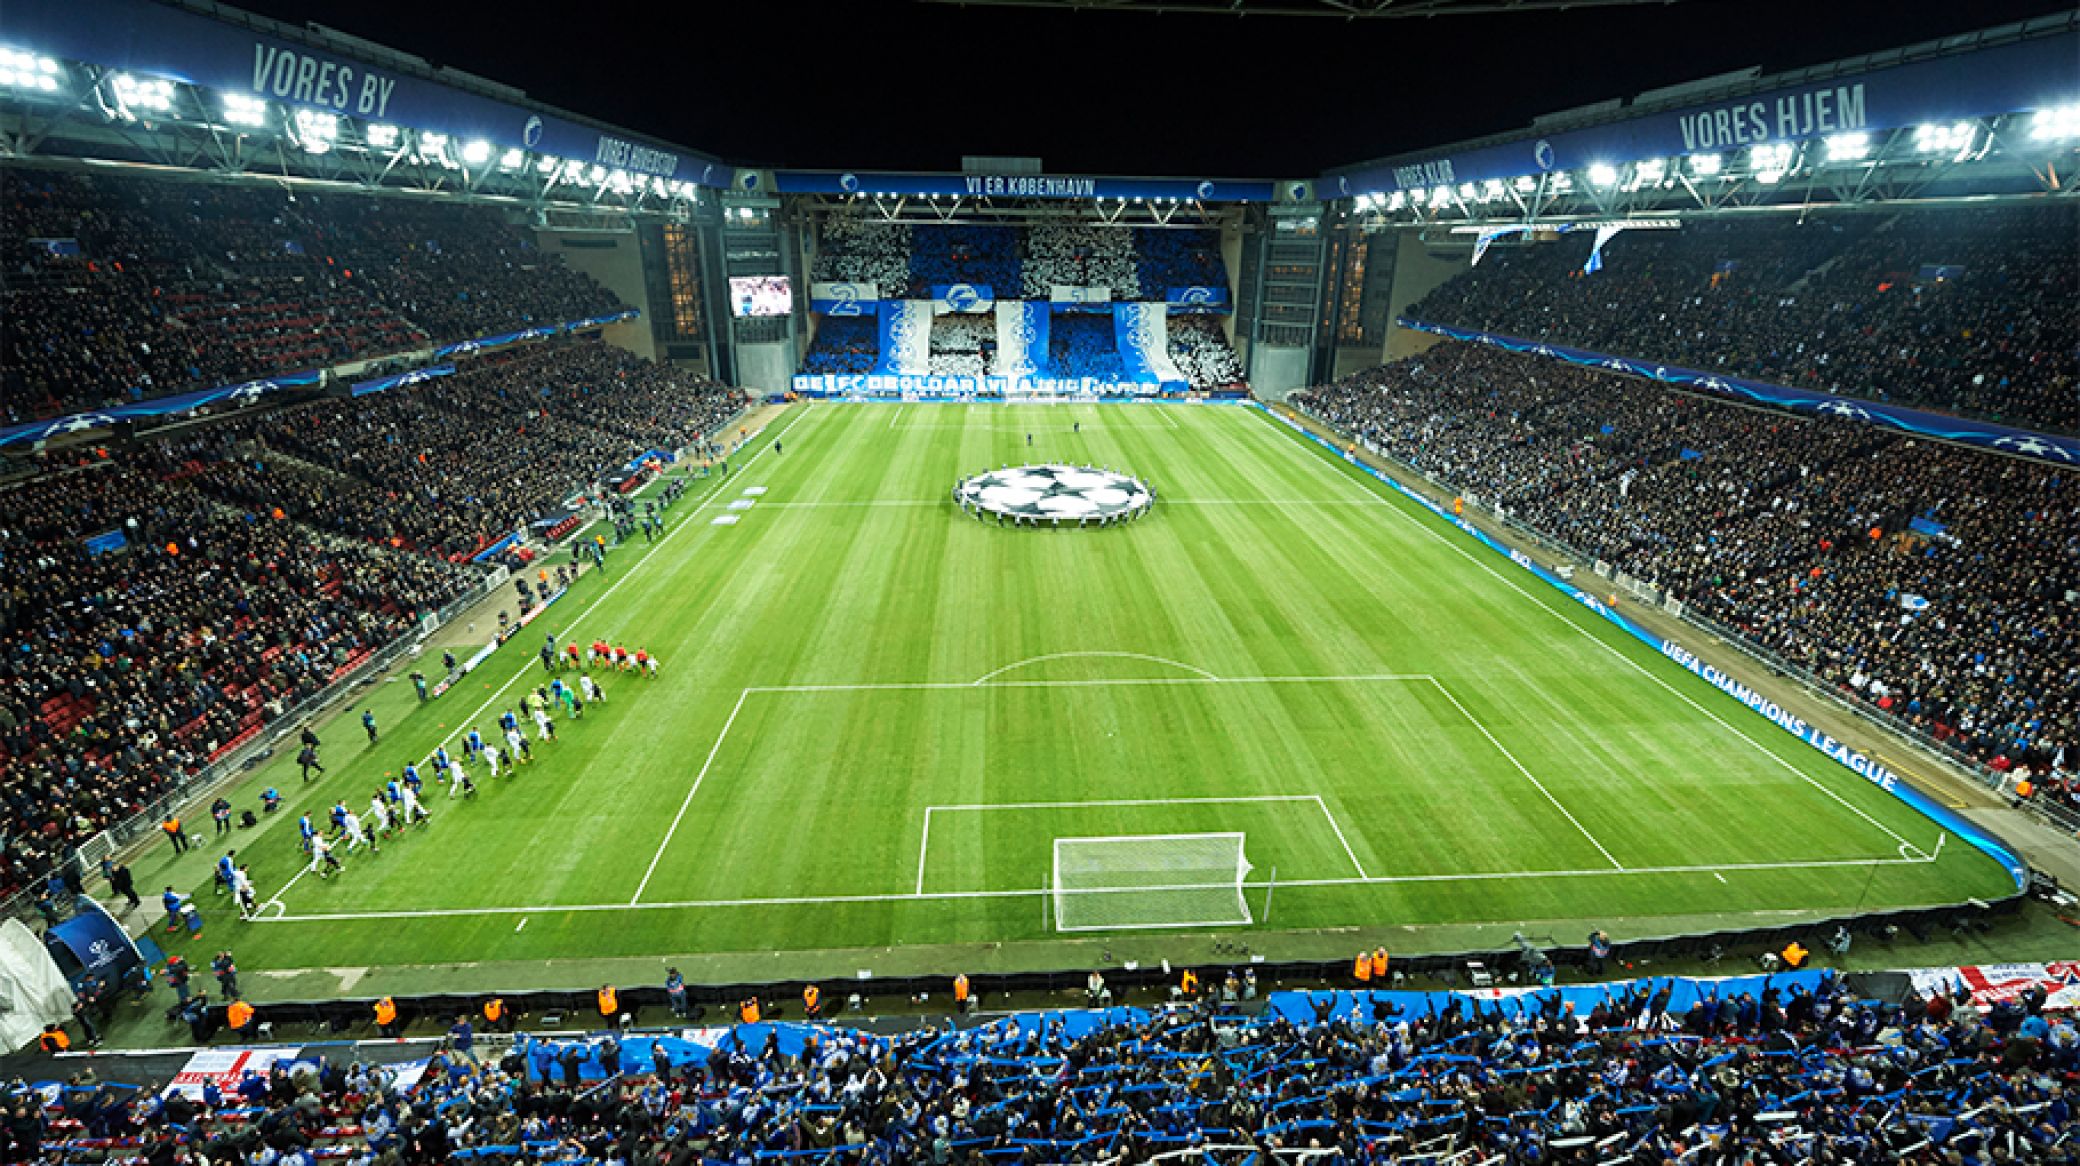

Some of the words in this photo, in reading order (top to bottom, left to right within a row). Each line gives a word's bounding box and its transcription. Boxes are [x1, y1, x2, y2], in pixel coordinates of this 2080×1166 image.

[253, 42, 353, 109] VORES
[358, 72, 396, 118] BY
[1679, 102, 1768, 151] VORES
[1776, 83, 1866, 139] HJEM
[966, 177, 981, 193] VI
[984, 177, 1004, 194] ER
[1661, 638, 1700, 681] UEFA
[1702, 664, 1807, 737] CHAMPIONS
[1809, 728, 1898, 793] LEAGUE
